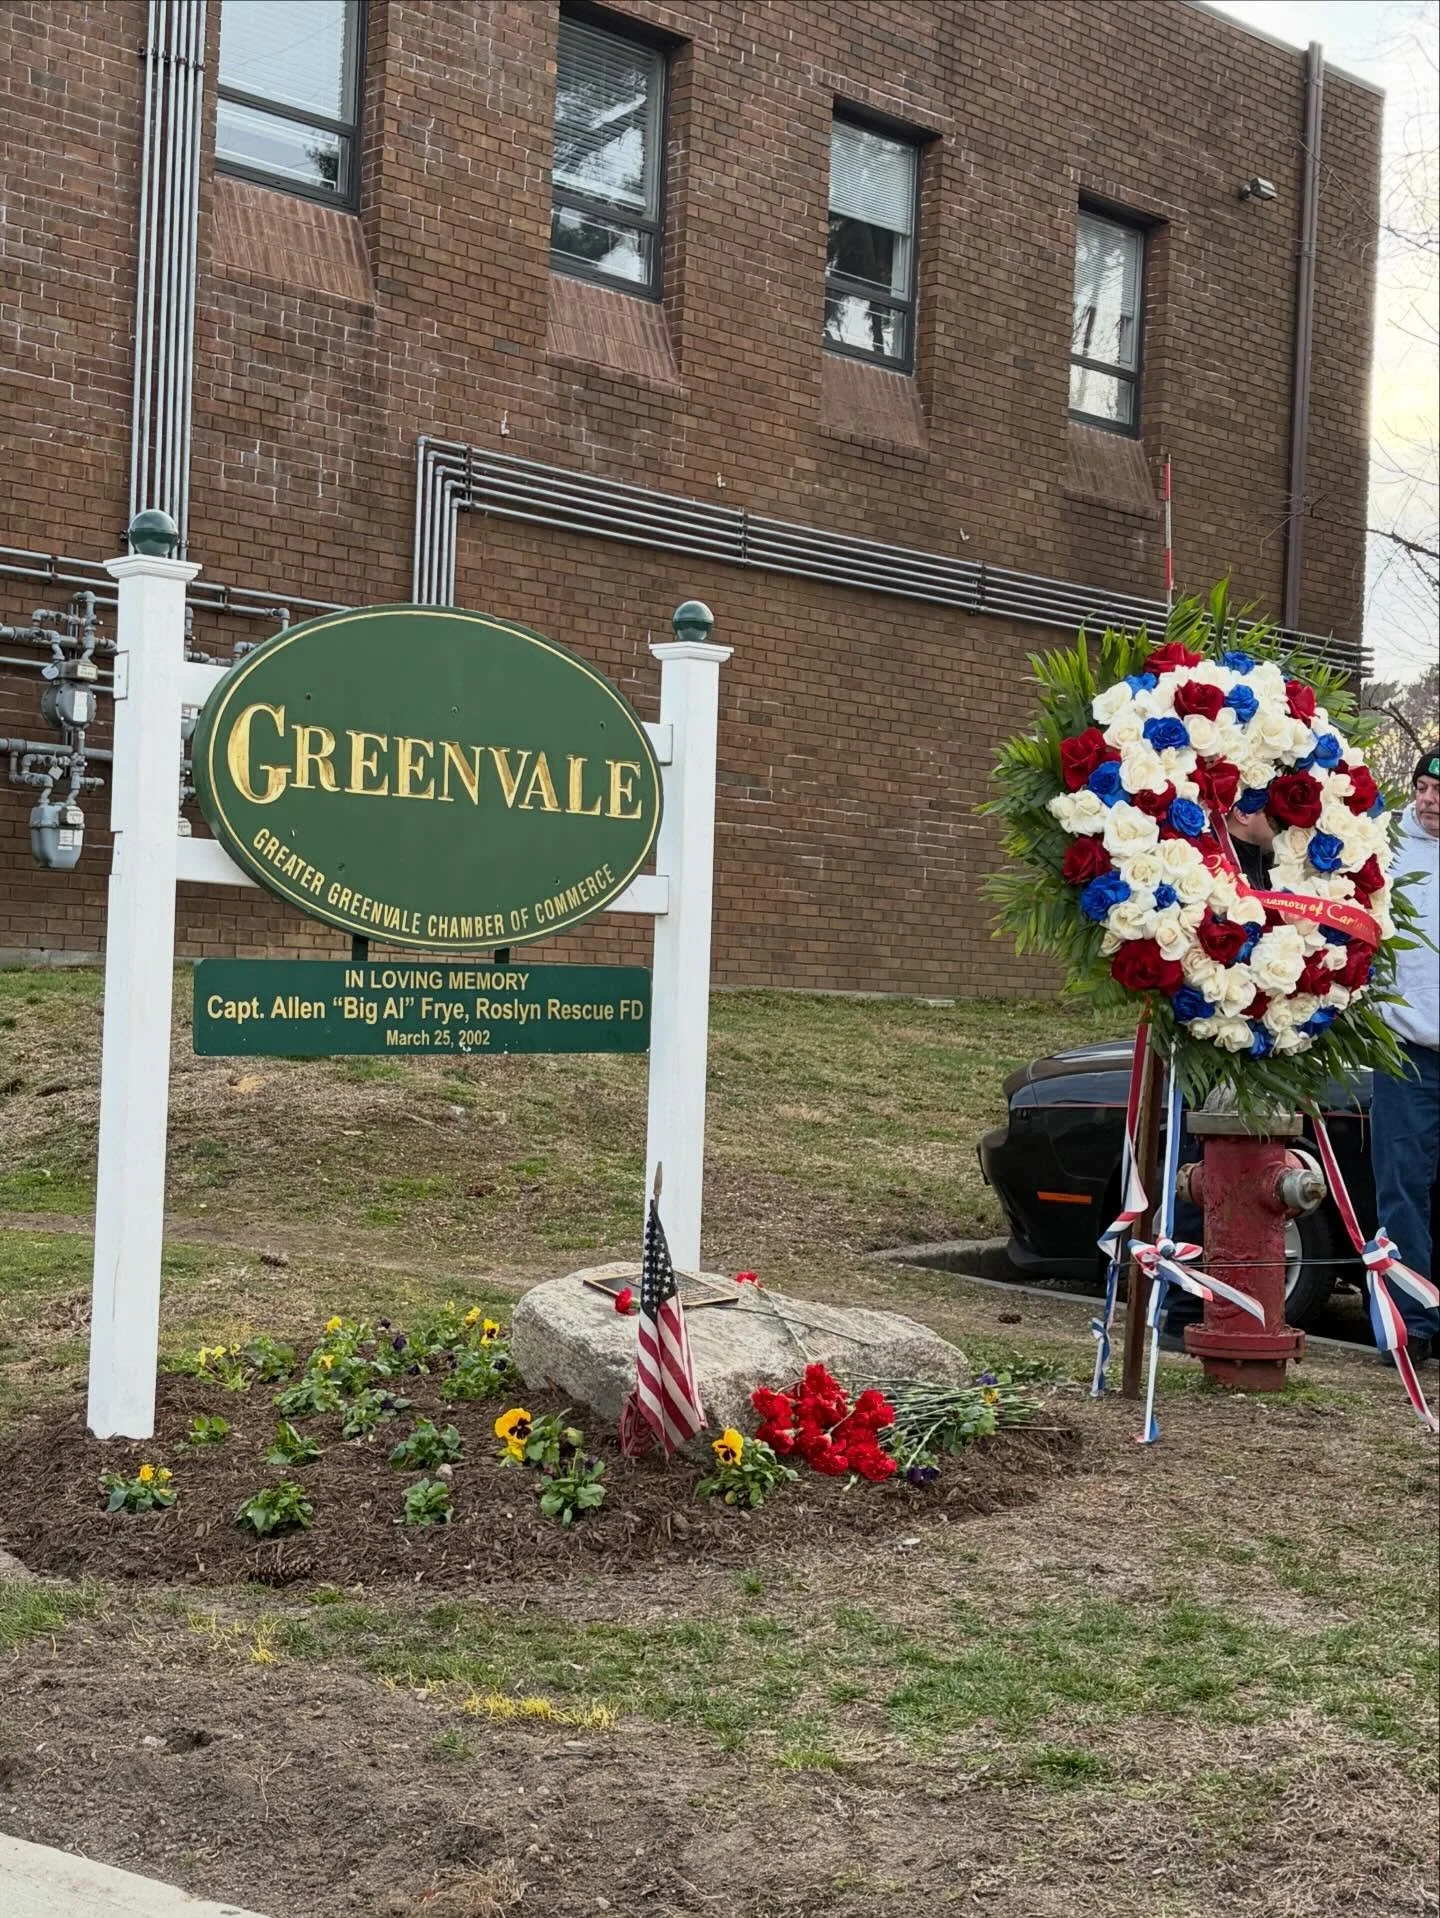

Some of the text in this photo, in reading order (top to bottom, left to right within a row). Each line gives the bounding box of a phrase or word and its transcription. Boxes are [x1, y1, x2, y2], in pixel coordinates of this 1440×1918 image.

[227, 702, 643, 820] GREENVALE
[253, 828, 616, 939] GREATER GREENVALE CHAMBER OF COMMERCE
[1309, 902, 1323, 917] of
[345, 969, 530, 991] IN LOVING MEMORY
[207, 994, 265, 1025] Capt.
[270, 996, 326, 1020] Allen
[421, 997, 470, 1025] Frye,
[476, 998, 541, 1025] Roslyn
[547, 999, 615, 1021] Rescue
[620, 999, 644, 1021] FD
[386, 1029, 491, 1048] March 25, 2002
